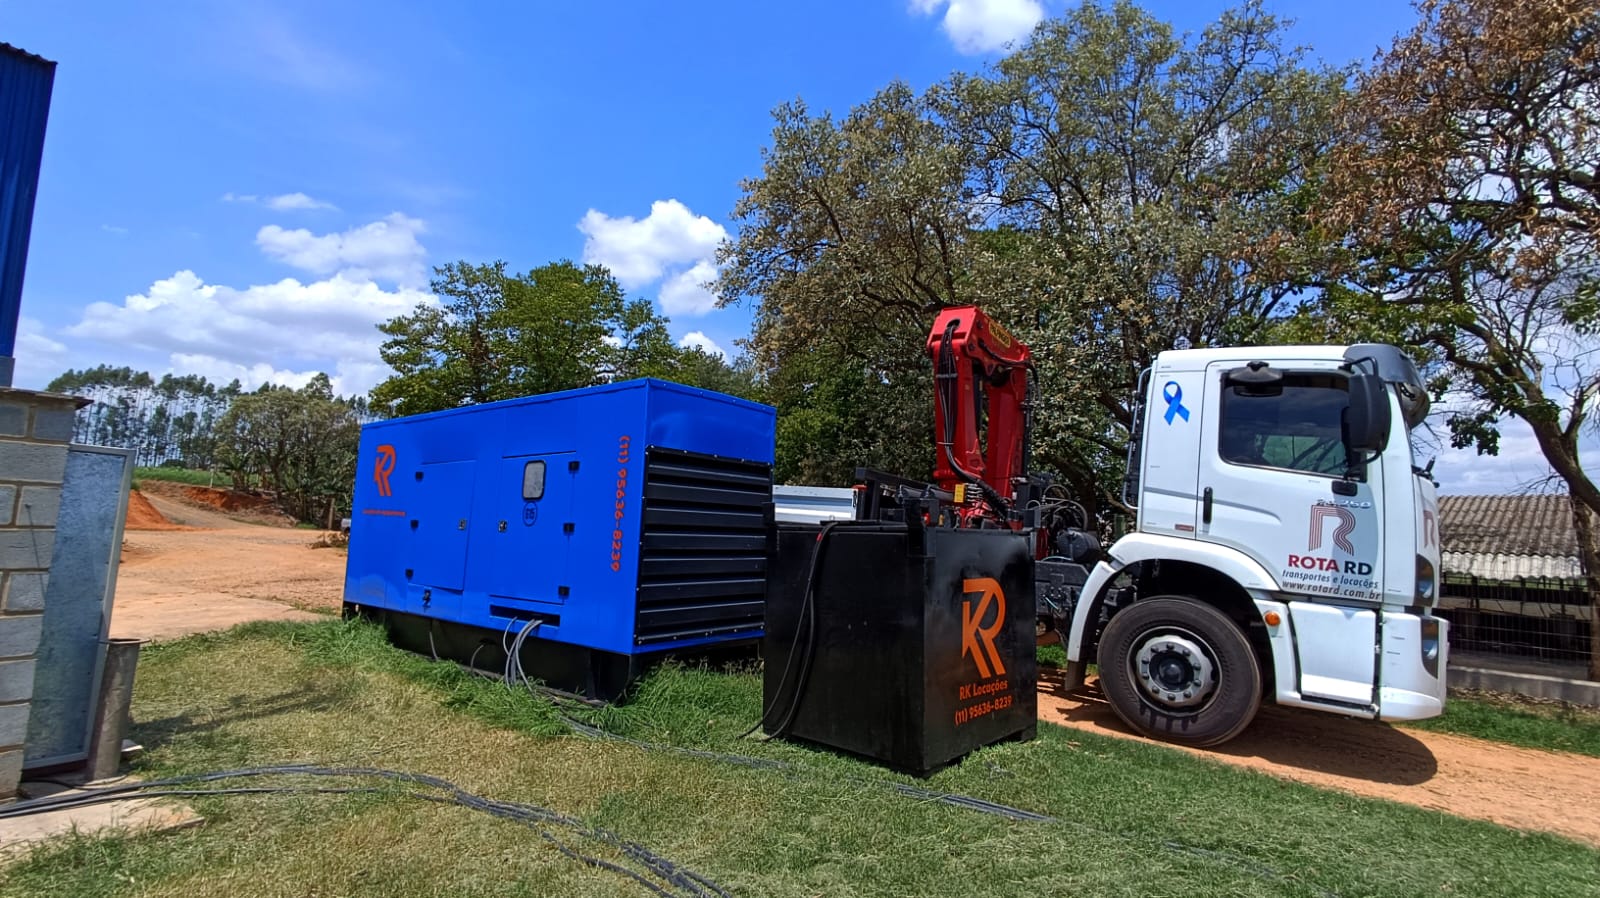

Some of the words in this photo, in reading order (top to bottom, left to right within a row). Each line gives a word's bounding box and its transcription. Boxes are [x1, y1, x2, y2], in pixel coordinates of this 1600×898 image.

[617, 435, 630, 463] (11)
[610, 468, 627, 572] 95636-8239
[1288, 554, 1340, 573] ROTA
[1344, 560, 1373, 576] RD
[1282, 569, 1330, 583] transportes
[1340, 575, 1379, 590] locações
[1282, 580, 1382, 600] www.rotard.com.br
[959, 684, 972, 700] RK
[954, 708, 968, 726] (11)
[969, 695, 1013, 718] 95636-8239
